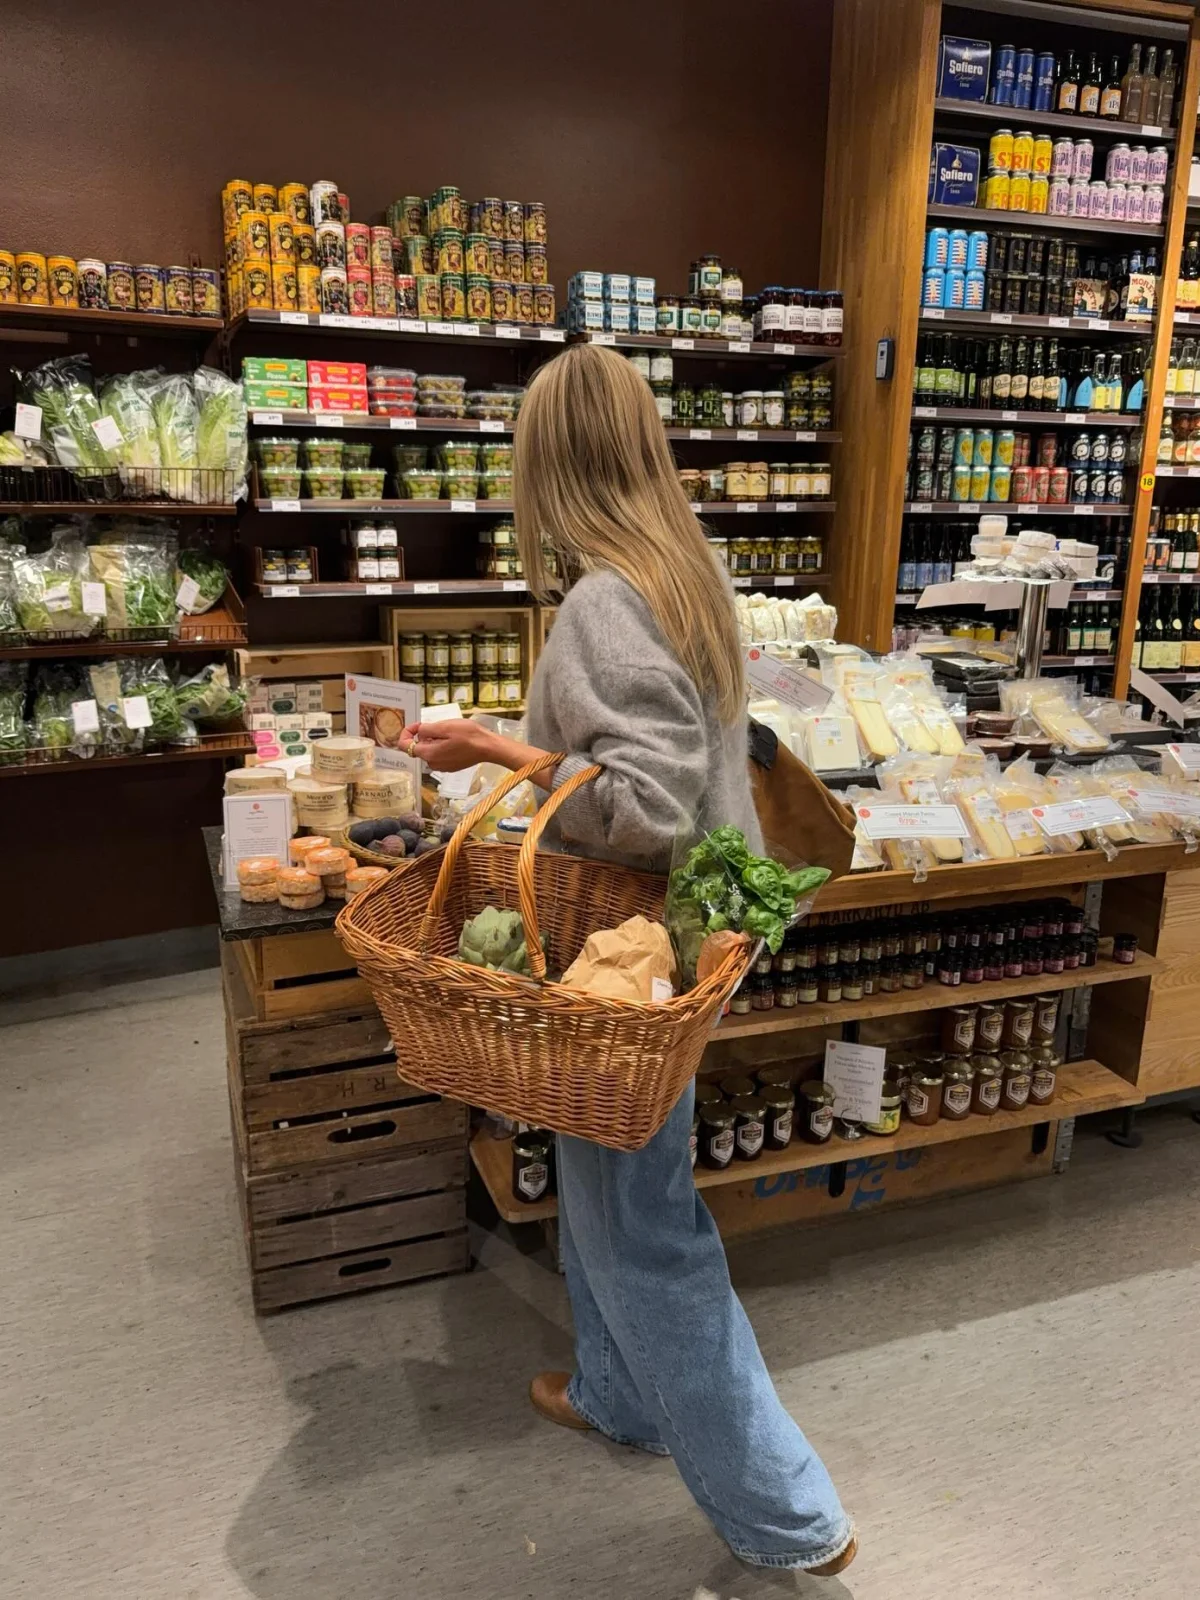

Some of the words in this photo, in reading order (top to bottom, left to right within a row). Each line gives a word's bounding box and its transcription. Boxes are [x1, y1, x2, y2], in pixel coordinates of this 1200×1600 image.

[949, 60, 983, 75] Sofiero
[941, 167, 973, 182] Sofiero
[1143, 477, 1153, 486] 18
